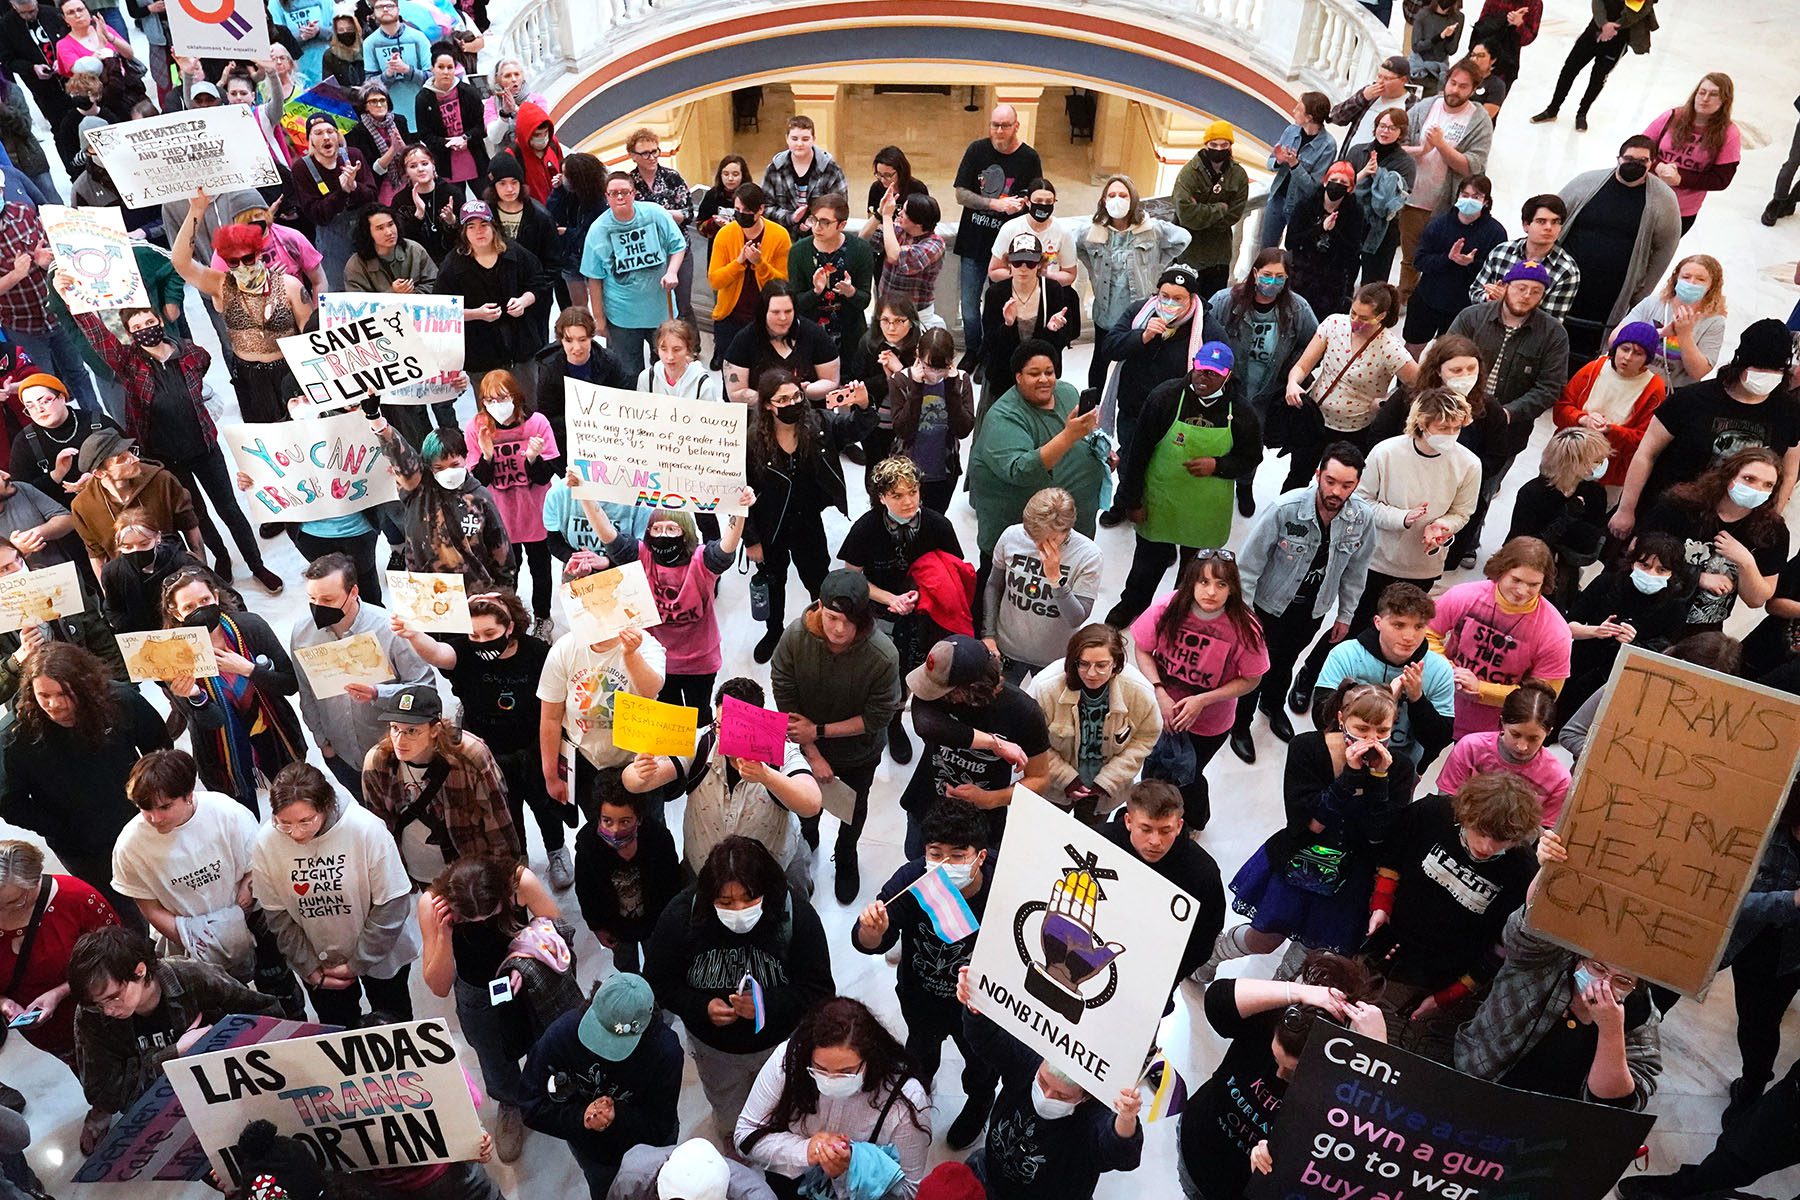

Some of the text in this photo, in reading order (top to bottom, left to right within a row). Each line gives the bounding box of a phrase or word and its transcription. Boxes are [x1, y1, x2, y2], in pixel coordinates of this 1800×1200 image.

[620, 229, 646, 245] STOP
[625, 242, 646, 256] THE
[617, 252, 662, 271] ATTACK
[309, 317, 384, 355] SAVE
[301, 337, 399, 382] TRANS
[333, 355, 423, 400] LIVES
[574, 385, 739, 434] We must do away
[575, 432, 624, 444] pressures
[603, 424, 620, 436] any
[658, 432, 675, 440] of
[678, 434, 713, 447] gender
[718, 435, 741, 447] that
[494, 459, 518, 473] THE
[578, 448, 598, 459] that
[604, 454, 618, 462] we
[626, 457, 649, 466] are
[573, 459, 662, 490] TRANS
[635, 490, 721, 511] NOW
[1008, 590, 1061, 618] HUGS
[1473, 626, 1518, 654] STOP
[1172, 645, 1200, 666] THE
[1474, 644, 1504, 667] THE
[571, 668, 589, 685] KEEP
[1623, 665, 1796, 751] TRANS
[940, 745, 987, 773] Trans
[1603, 722, 1727, 791] KIDS
[1575, 768, 1764, 865] DESERVE
[291, 866, 344, 882] RIGHTS
[294, 854, 346, 869] TRANS
[1565, 821, 1736, 909] HEALTH
[313, 879, 342, 893] ARE
[299, 895, 344, 908] HUMAN
[300, 904, 352, 919] RIGHTS
[1546, 866, 1695, 960] CARE
[978, 974, 1111, 1083] NONBINARIE
[189, 1022, 457, 1105] LAS VIDAS
[1324, 1037, 1401, 1086] Can:
[278, 1070, 434, 1126] TRANS
[1227, 1075, 1254, 1118] YOUR
[1335, 1079, 1428, 1132] drive
[1432, 1121, 1454, 1140] a
[1327, 1107, 1506, 1182] own a gun
[1300, 1160, 1365, 1200] buy
[1311, 1132, 1480, 1200] go to war
